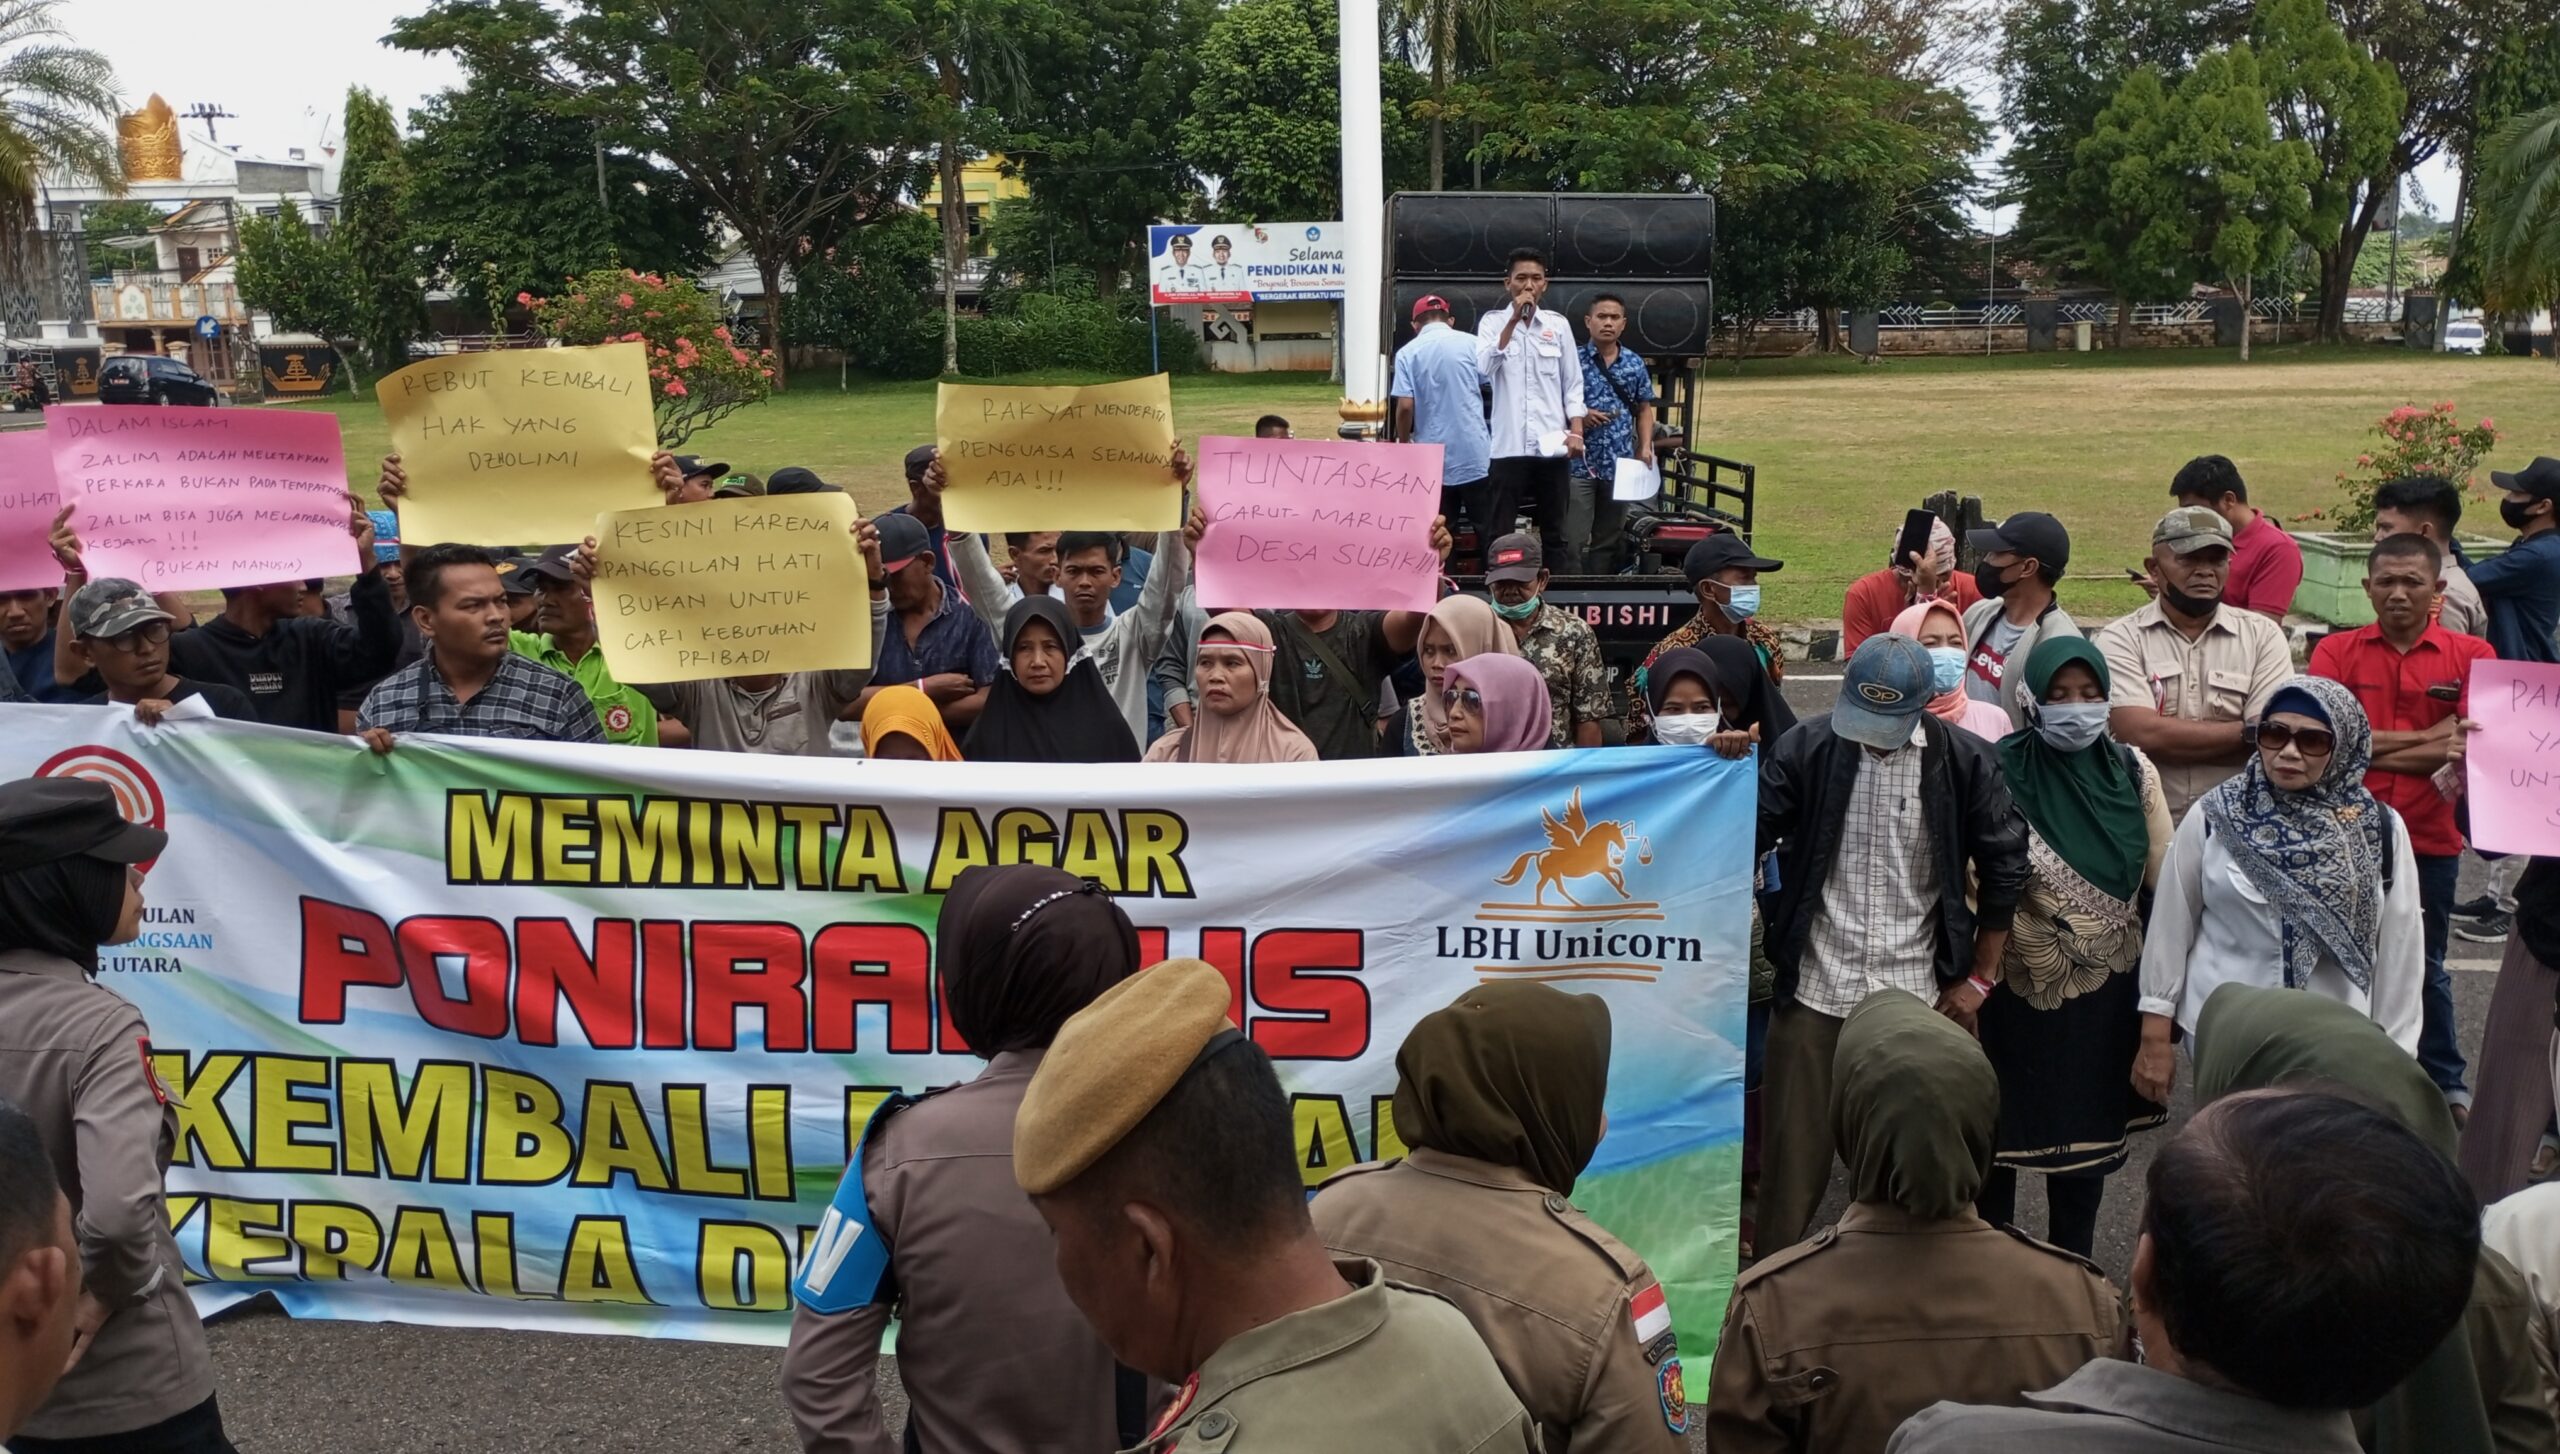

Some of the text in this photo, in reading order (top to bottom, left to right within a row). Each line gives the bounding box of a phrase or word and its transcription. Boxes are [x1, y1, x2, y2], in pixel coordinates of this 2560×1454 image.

[1247, 264, 1328, 276] PENDIDIKAN
[402, 369, 633, 397] REBUT KEMBALI
[983, 398, 1166, 423] RAKYAT MENDERITA
[67, 416, 228, 438] DALAM ISLAM
[423, 416, 577, 440] HAK YANG
[81, 450, 329, 469] ZALIM ADALAH MELETAKKAN
[469, 450, 578, 472] DZHOLIMI
[960, 440, 1074, 459] PENGUASA
[86, 478, 165, 494] PERKARA
[180, 475, 240, 489] BUKAN
[1213, 451, 1436, 495] TUNTASKAN
[87, 509, 152, 530] ZALIM
[163, 510, 197, 523] BISA
[208, 510, 244, 523] JUGA
[615, 514, 829, 548] KESINI KARENA
[1313, 508, 1414, 533] MARUT
[87, 537, 157, 552] KEJAM
[1237, 535, 1317, 563] DESA
[140, 557, 304, 583] (BUKAN MANUSIA)
[604, 553, 821, 579] PANGGILAN HATI
[618, 590, 811, 616] BUKAN UNTUK
[624, 622, 817, 650] CARI KEBUTUHAN
[679, 650, 770, 668] PRIBADI
[446, 788, 1197, 898] MEMINTA AGAR
[1436, 926, 1703, 962] LBH Unicorn
[113, 957, 182, 973] UTARA
[150, 1049, 796, 1202] KEMBALI
[165, 1192, 670, 1307] KEPALA
